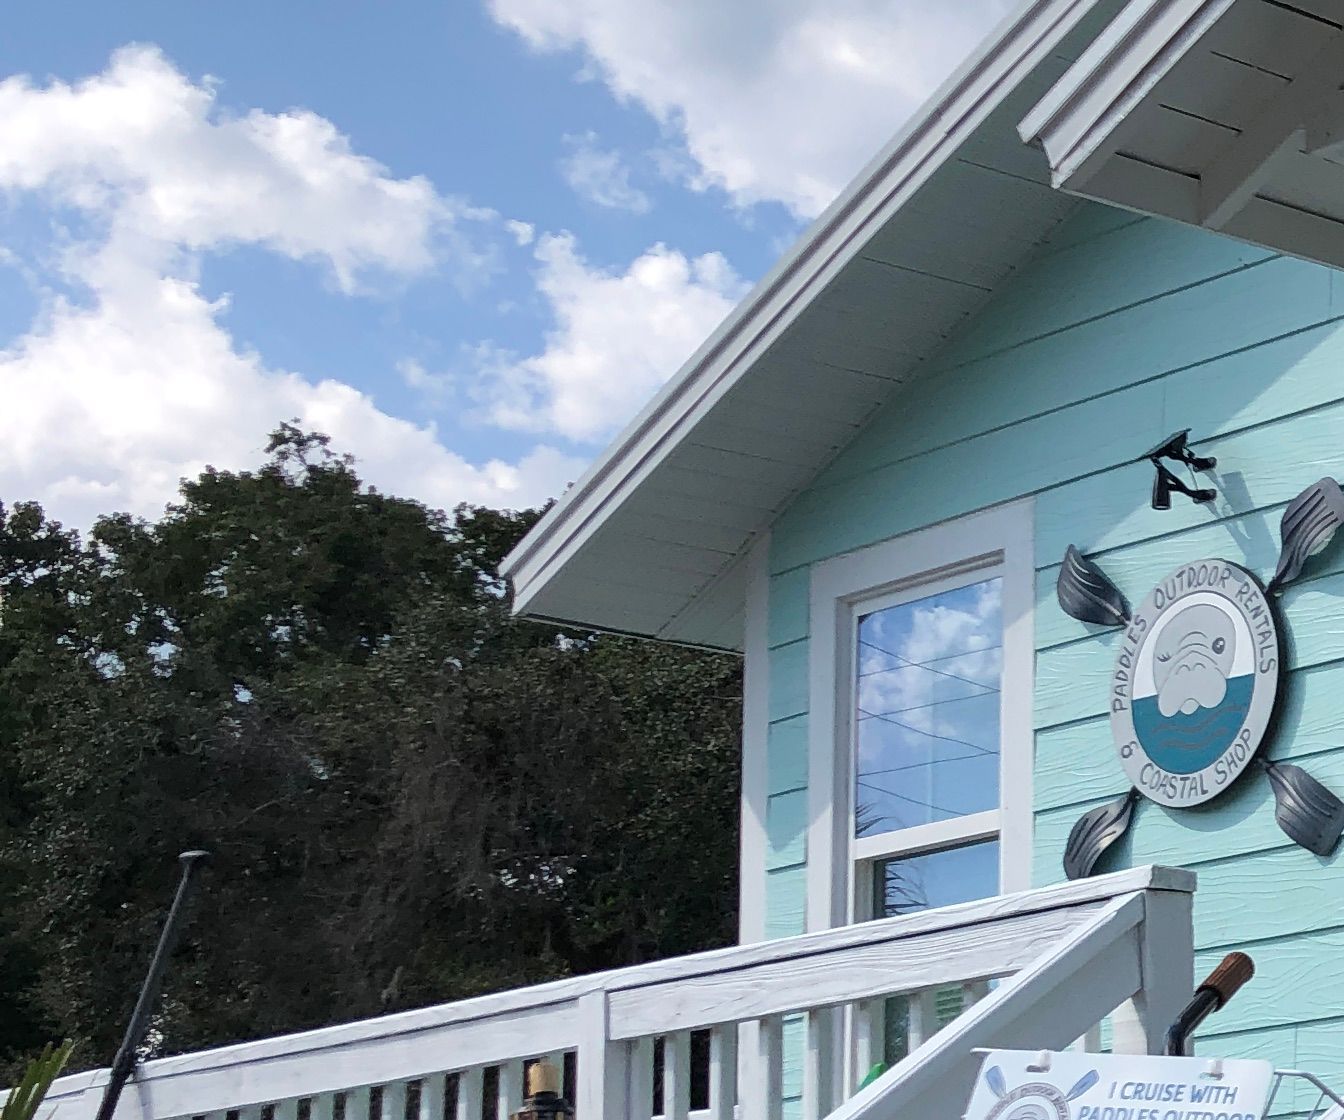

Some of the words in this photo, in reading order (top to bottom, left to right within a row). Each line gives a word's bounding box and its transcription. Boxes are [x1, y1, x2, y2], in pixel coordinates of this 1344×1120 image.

[1112, 617, 1148, 713] PADDLES
[1153, 566, 1234, 609] OUTDOOR
[1234, 584, 1277, 675] RENTALS
[1139, 762, 1209, 799] COASTAL
[1214, 727, 1252, 785] SHOP
[1109, 1082, 1117, 1098] I
[1120, 1082, 1183, 1103] CRUISE
[1192, 1084, 1238, 1104] WITH
